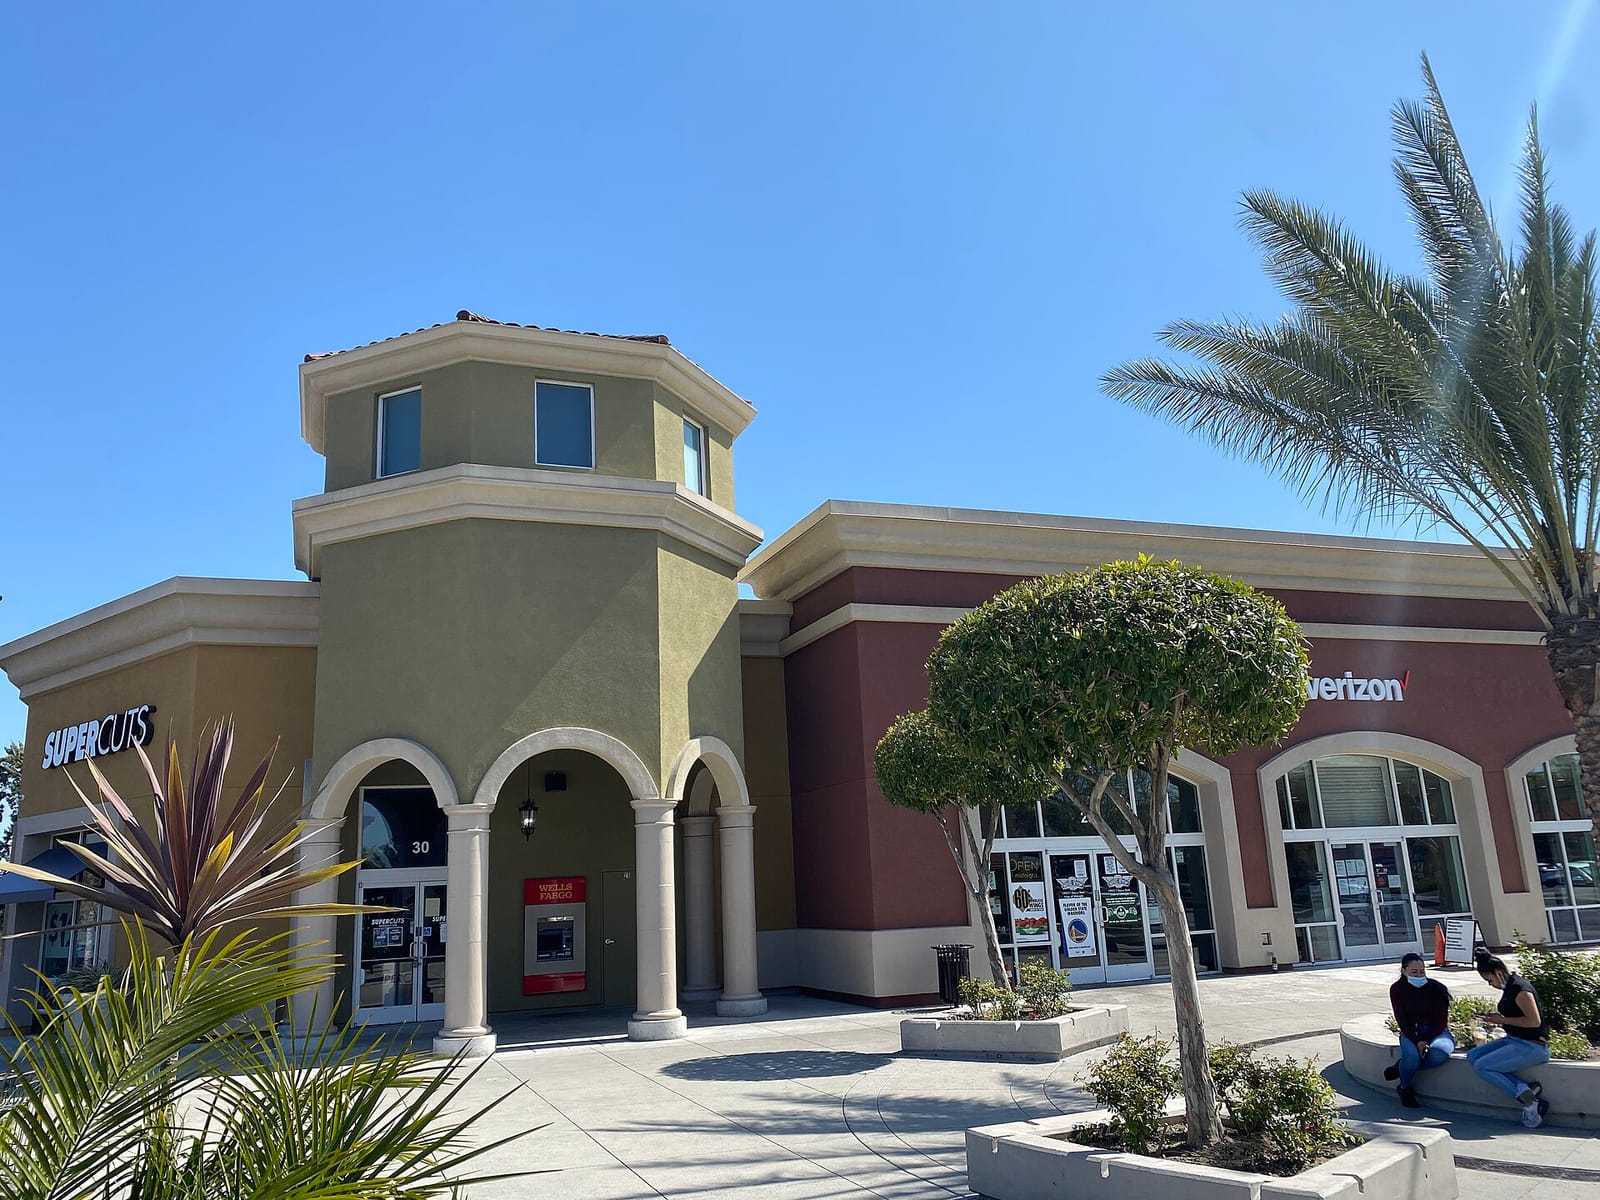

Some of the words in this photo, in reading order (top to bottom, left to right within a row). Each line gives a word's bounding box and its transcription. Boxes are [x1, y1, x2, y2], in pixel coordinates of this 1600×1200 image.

[1306, 671, 1403, 701] verizon
[42, 704, 149, 770] SUPERCUTS
[412, 841, 430, 854] 30
[539, 883, 573, 892] WELLS
[540, 891, 573, 900] FARGO
[371, 917, 405, 926] SUPERCUTS
